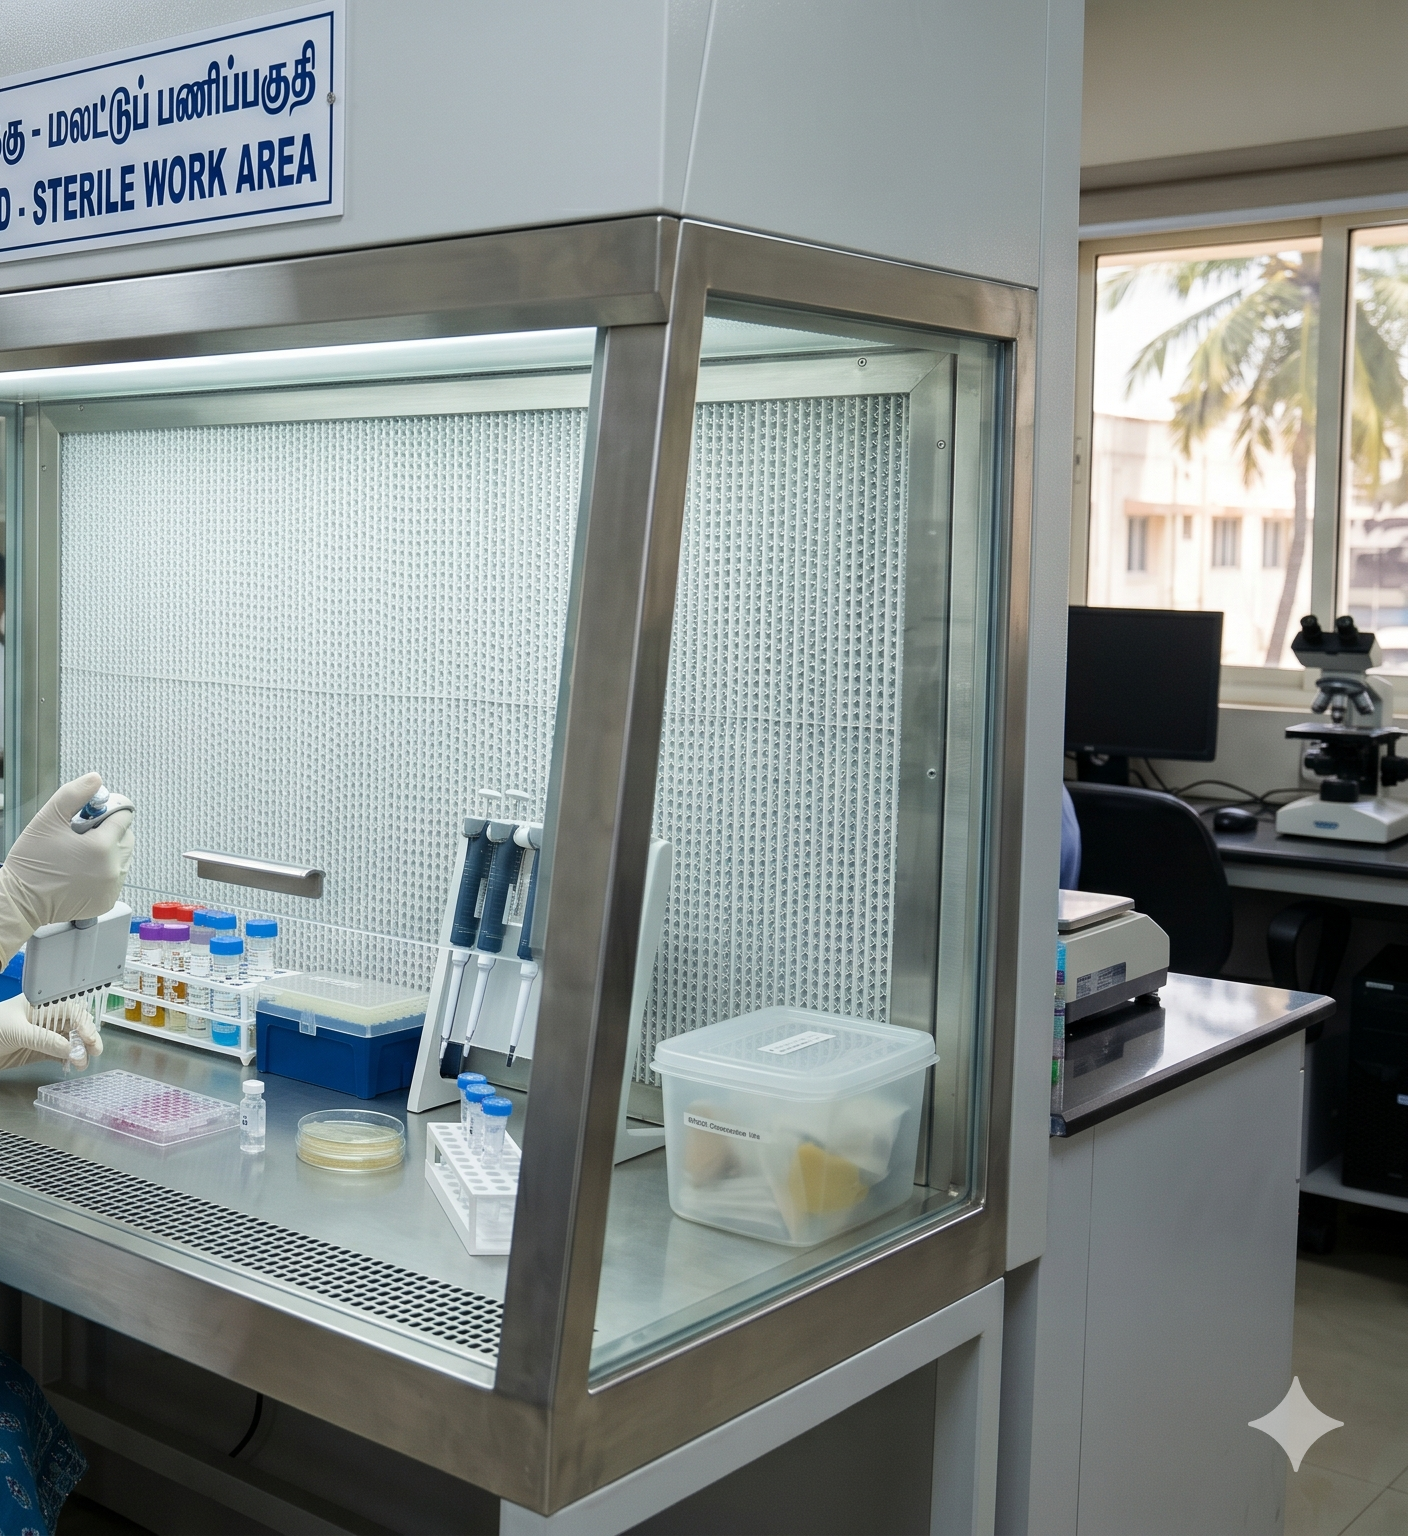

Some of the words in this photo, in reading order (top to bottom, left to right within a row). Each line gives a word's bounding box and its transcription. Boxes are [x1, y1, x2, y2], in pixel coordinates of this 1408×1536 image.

[31, 128, 41, 137] -
[48, 74, 149, 149] மலட்டுப்
[157, 39, 316, 117] பணிப்பகுதி
[19, 207, 25, 217] -
[32, 163, 136, 226] STERILE
[143, 147, 228, 209] WORK
[235, 132, 317, 194] AREA
